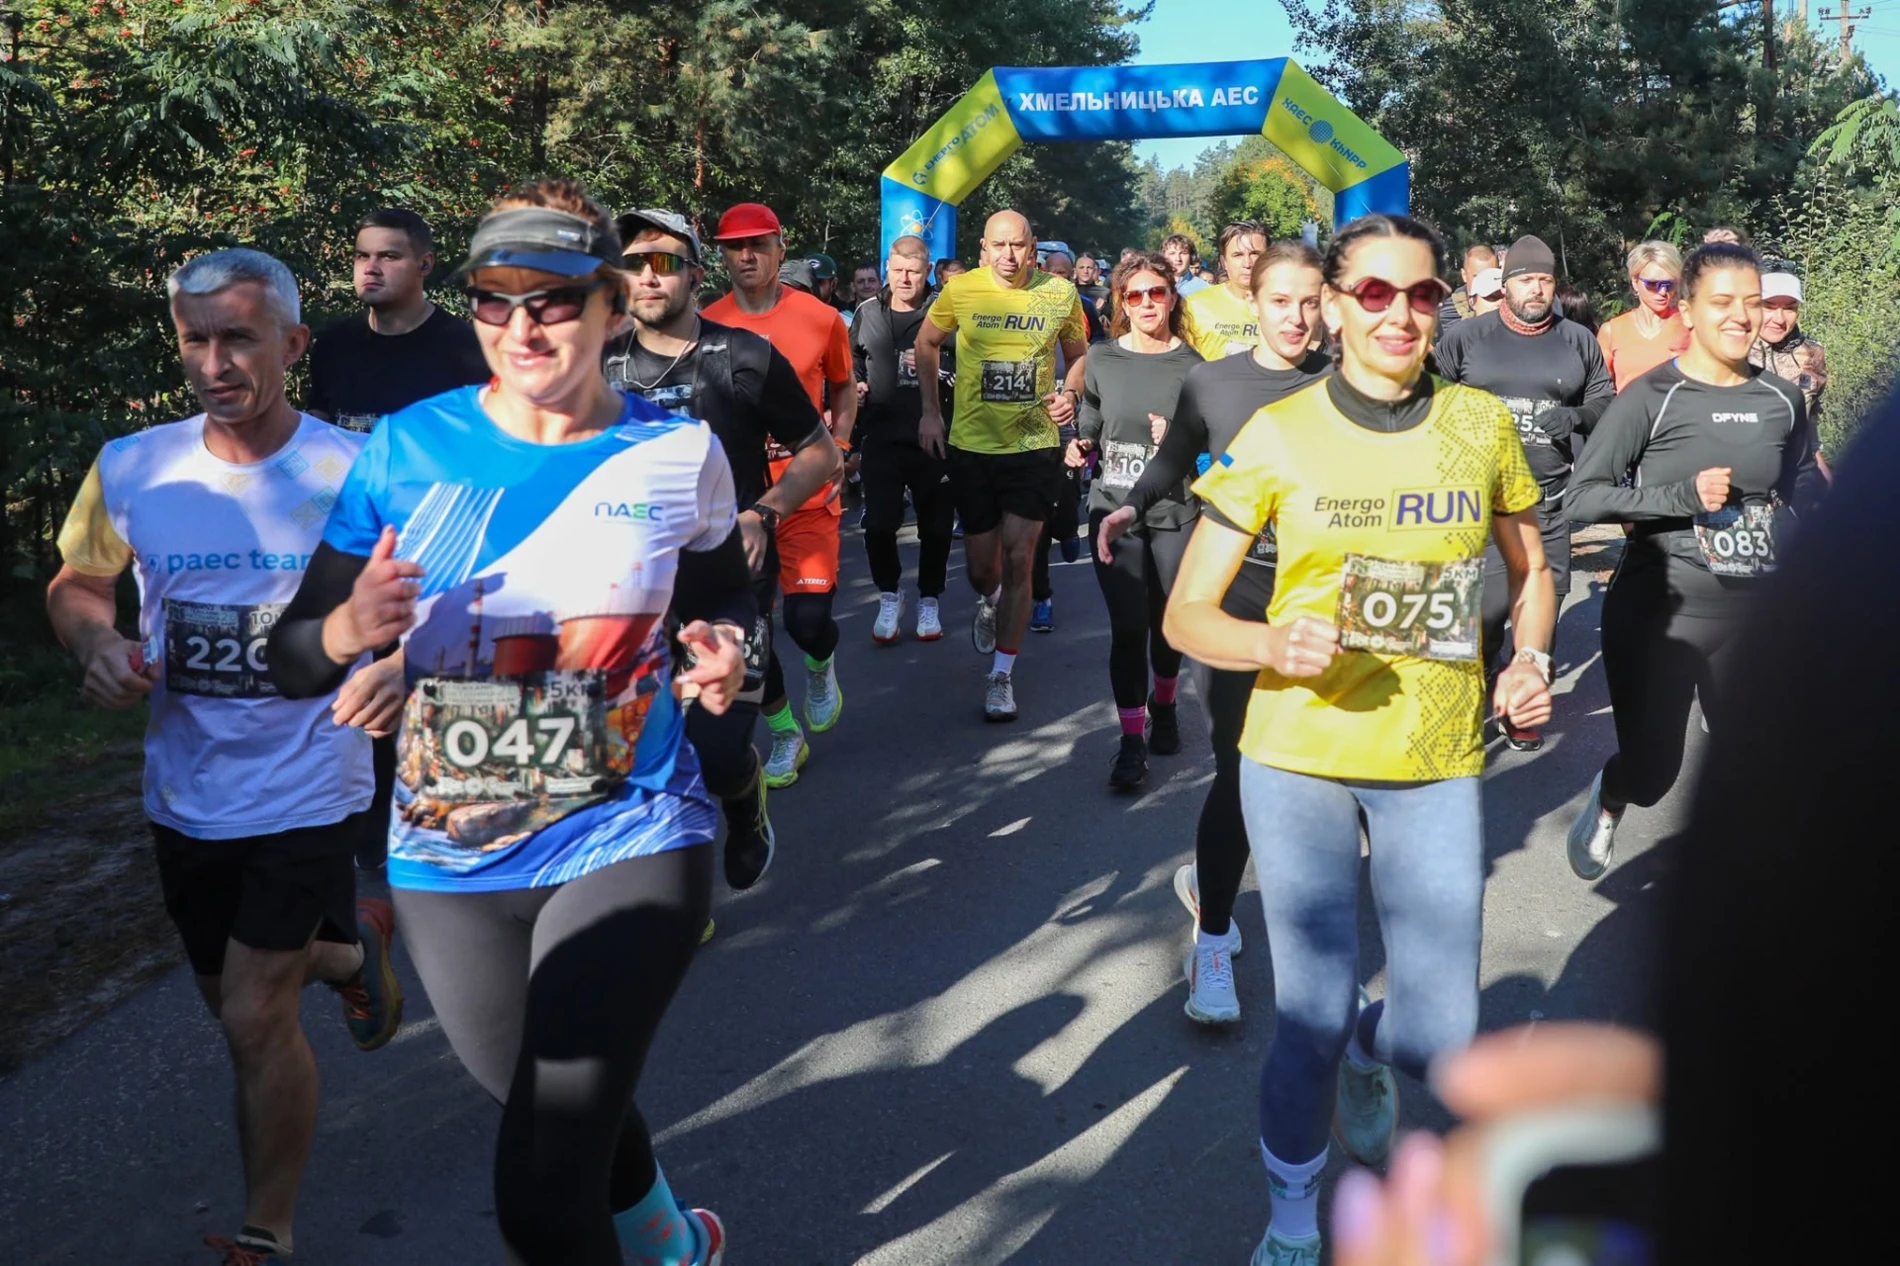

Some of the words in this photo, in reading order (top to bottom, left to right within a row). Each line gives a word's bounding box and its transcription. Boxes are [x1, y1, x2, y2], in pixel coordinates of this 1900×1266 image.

[1019, 88, 1204, 112] ХМЕЛЬНИЦЬКА
[1211, 86, 1259, 106] АЕС
[1329, 138, 1367, 169] KhNPP
[972, 313, 1003, 323] Energo
[976, 320, 1000, 329] Atom
[1004, 315, 1046, 331] RUN
[1214, 322, 1241, 331] Energo
[992, 374, 1026, 391] 214
[1314, 495, 1386, 514] Energo
[1396, 489, 1481, 526] RUN
[1328, 512, 1383, 529] Atom
[1713, 530, 1769, 557] 083
[1363, 591, 1455, 629] 075
[444, 716, 576, 768] 047
